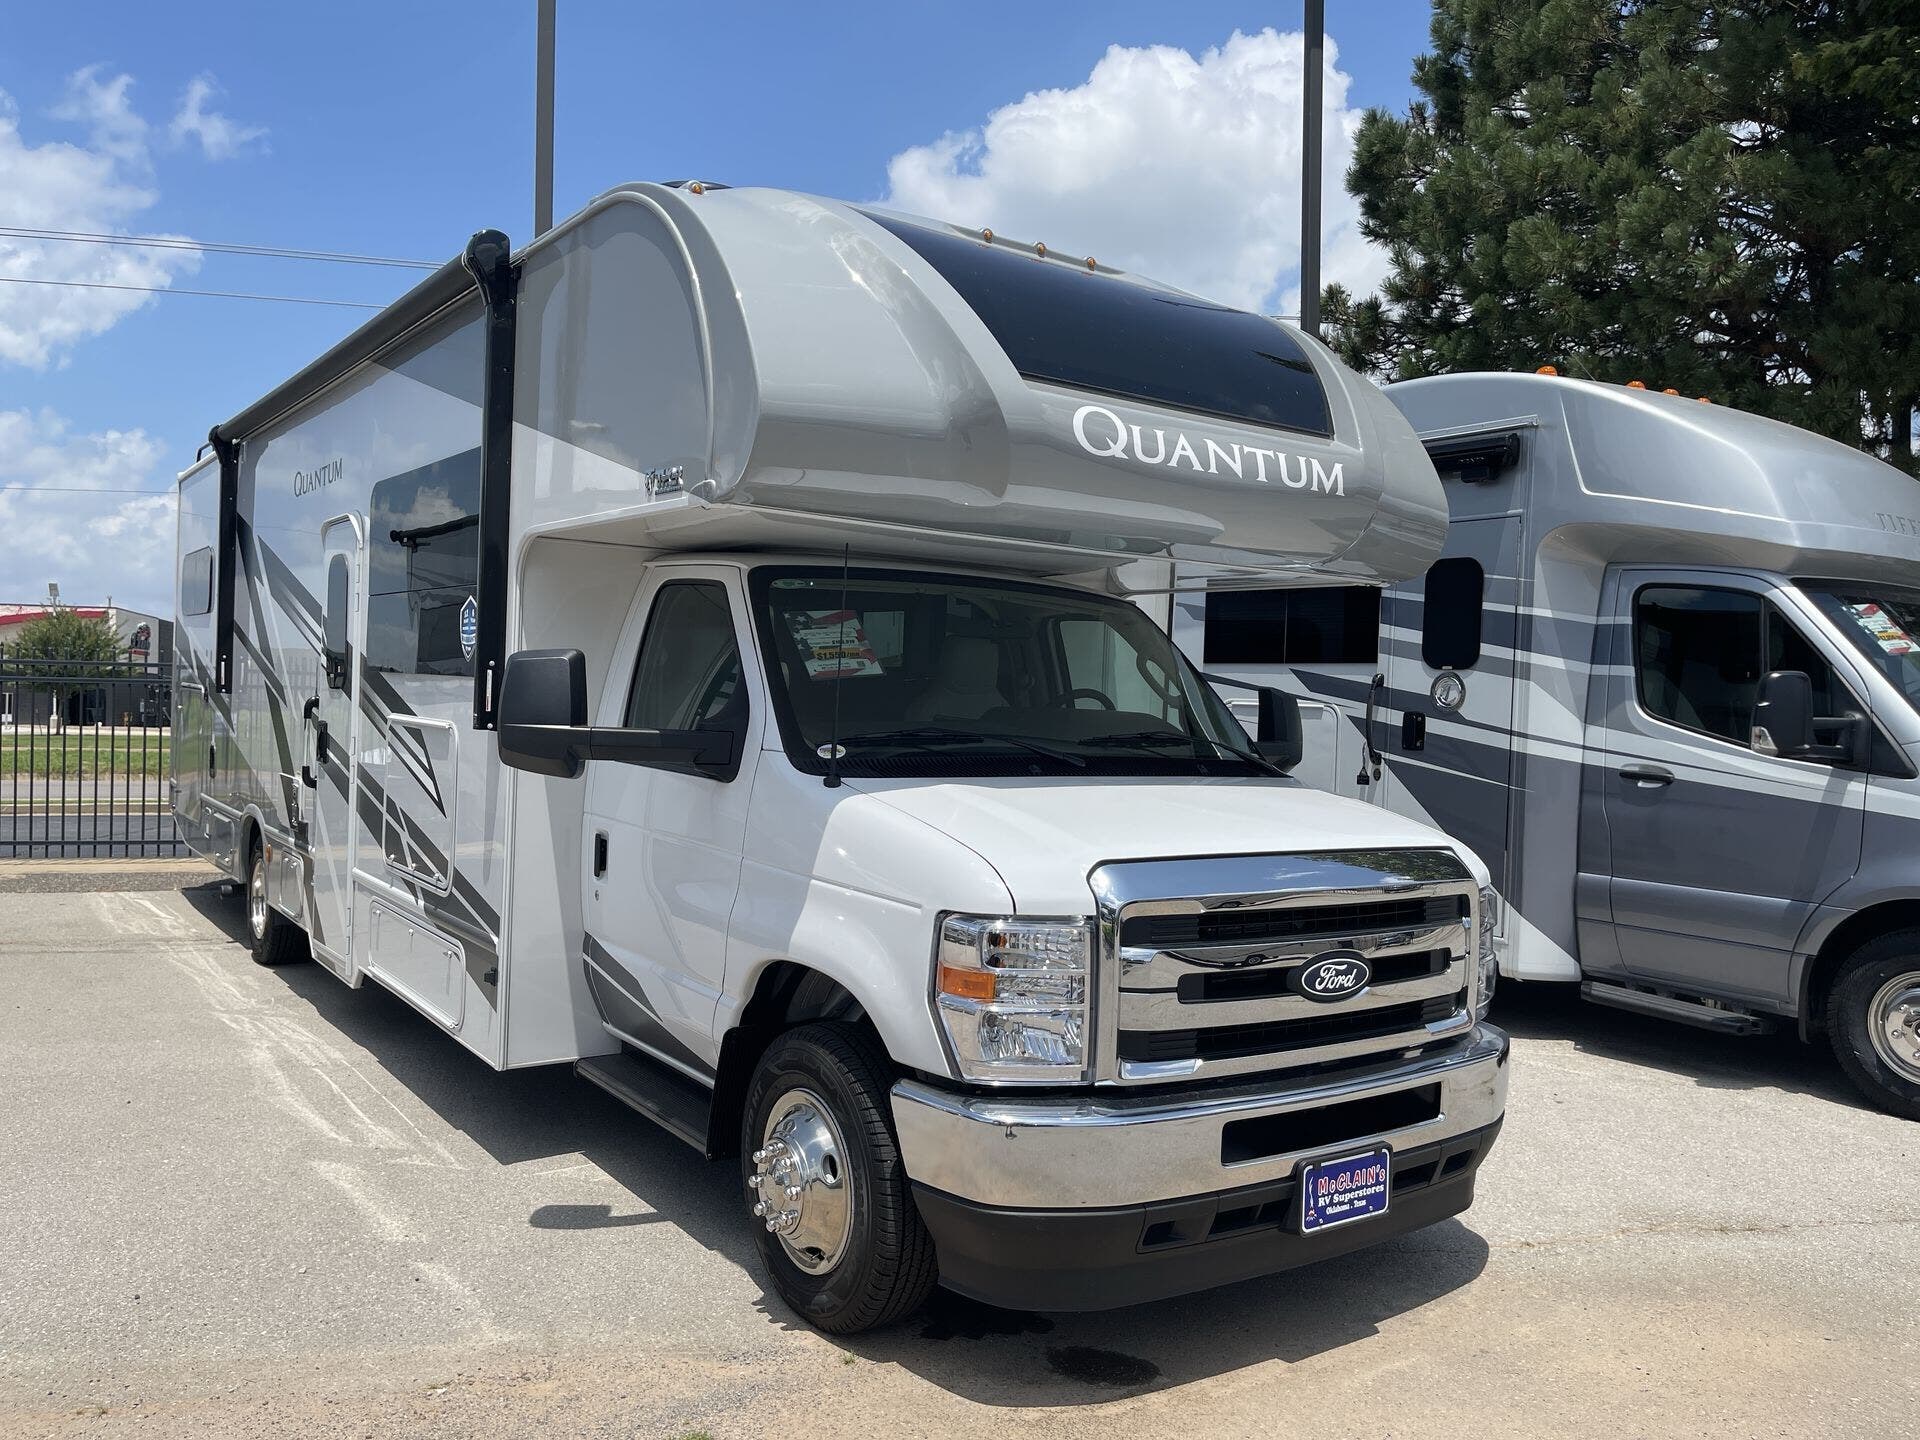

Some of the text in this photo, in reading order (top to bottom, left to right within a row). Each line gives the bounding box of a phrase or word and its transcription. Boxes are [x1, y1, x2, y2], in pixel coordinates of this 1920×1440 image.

[1073, 405, 1345, 496] QUANTUM
[294, 458, 343, 497] QUANTUM
[1315, 964, 1357, 990] Ford
[1318, 1184, 1385, 1207] RV Superstores
[1326, 1199, 1367, 1215] Oklahoma Texas
